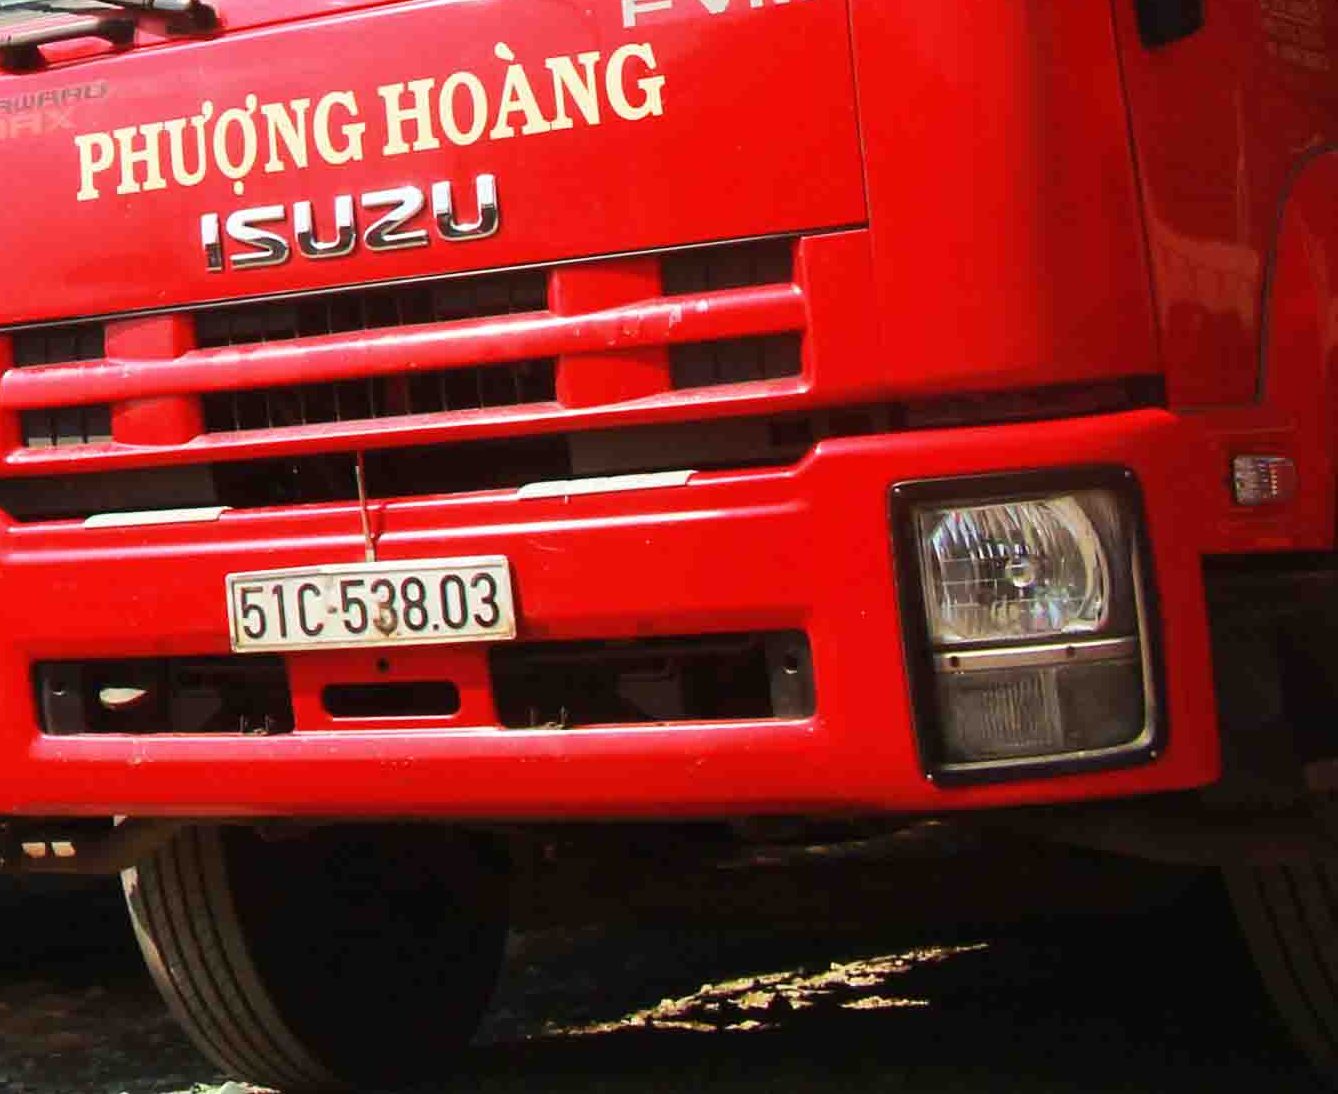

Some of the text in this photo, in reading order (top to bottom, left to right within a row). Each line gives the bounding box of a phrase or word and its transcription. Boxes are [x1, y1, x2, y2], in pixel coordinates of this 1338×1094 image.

[75, 42, 665, 203] PHƯỢNG HOÀNG
[200, 173, 500, 273] ISUZU
[239, 572, 501, 640] 51C-538.03
